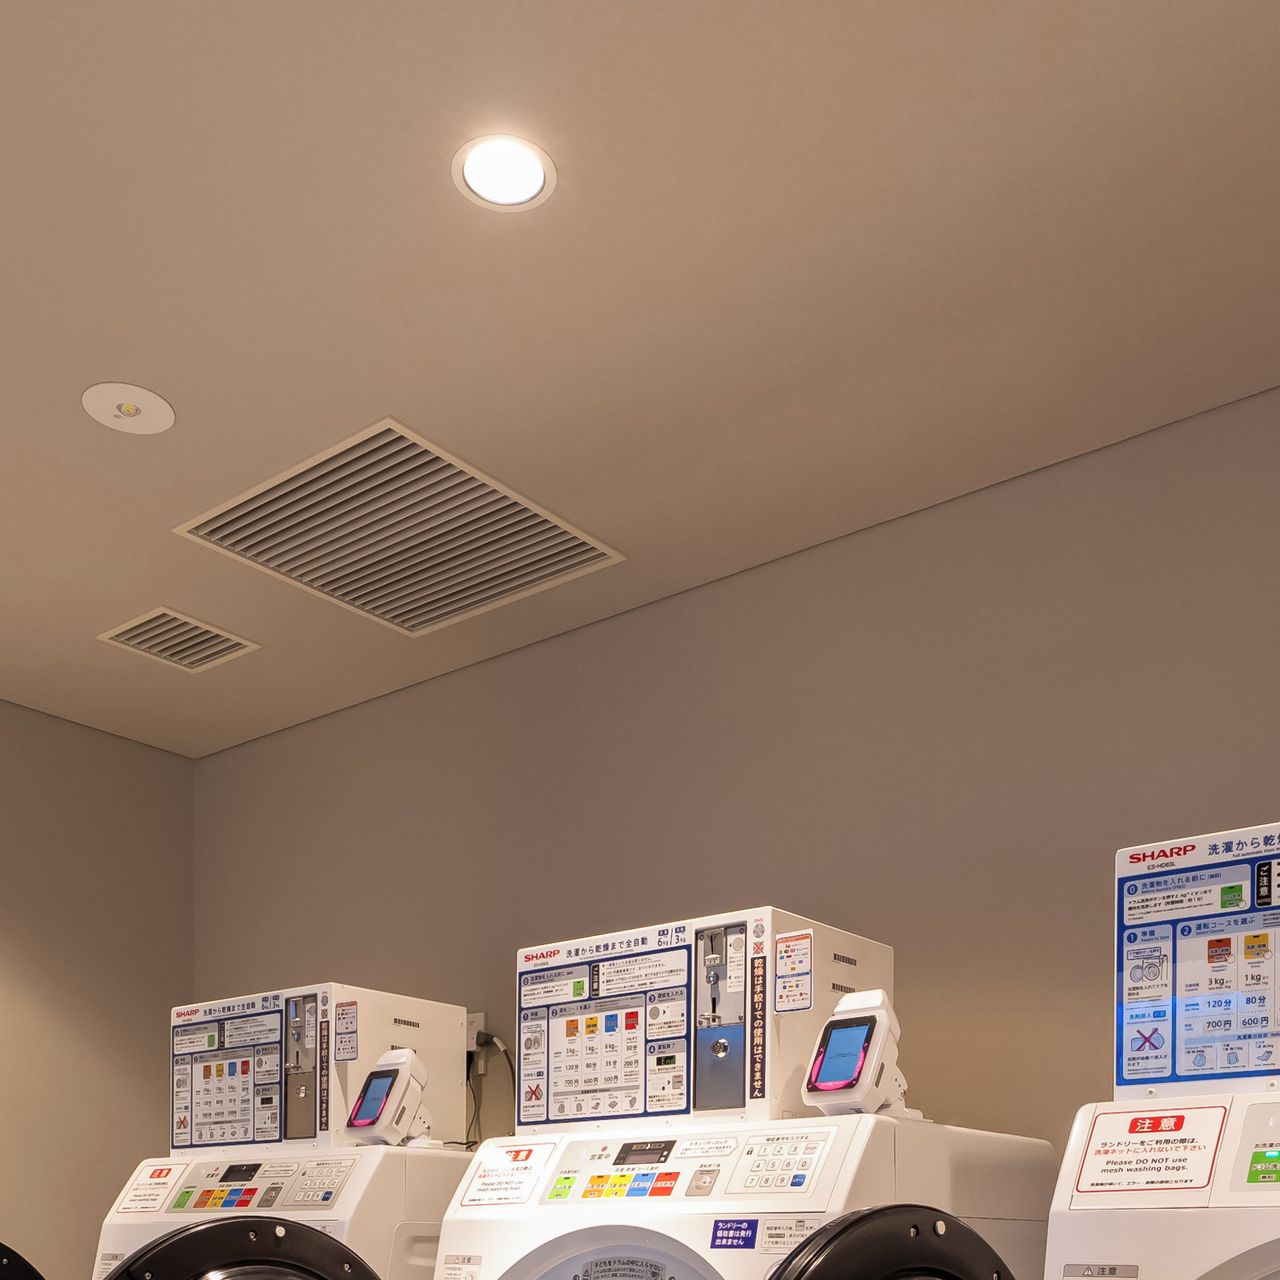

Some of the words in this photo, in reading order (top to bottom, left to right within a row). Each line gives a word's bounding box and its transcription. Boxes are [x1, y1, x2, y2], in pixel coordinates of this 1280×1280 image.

[1129, 844, 1196, 864] SHARP
[1196, 917, 1256, 931] 運転コースを選ぶ
[524, 950, 560, 962] SHARP
[1208, 999, 1232, 1008] 120分
[1246, 995, 1266, 1005] 80分
[176, 1009, 199, 1018] SHARP
[1206, 1020, 1232, 1029] 700円
[1242, 1016, 1269, 1026] 600円
[1135, 1117, 1177, 1133] 注意
[1100, 1138, 1199, 1149] ランドリーをご利用の際は、
[1094, 1144, 1206, 1156] 洗濯ネットに入れないで下さい
[1151, 1157, 1169, 1165] NOT
[1101, 1166, 1124, 1174] mesh
[1126, 1165, 1162, 1174] washing
[1165, 1164, 1189, 1172] bags.
[1097, 1266, 1117, 1276] 注意
